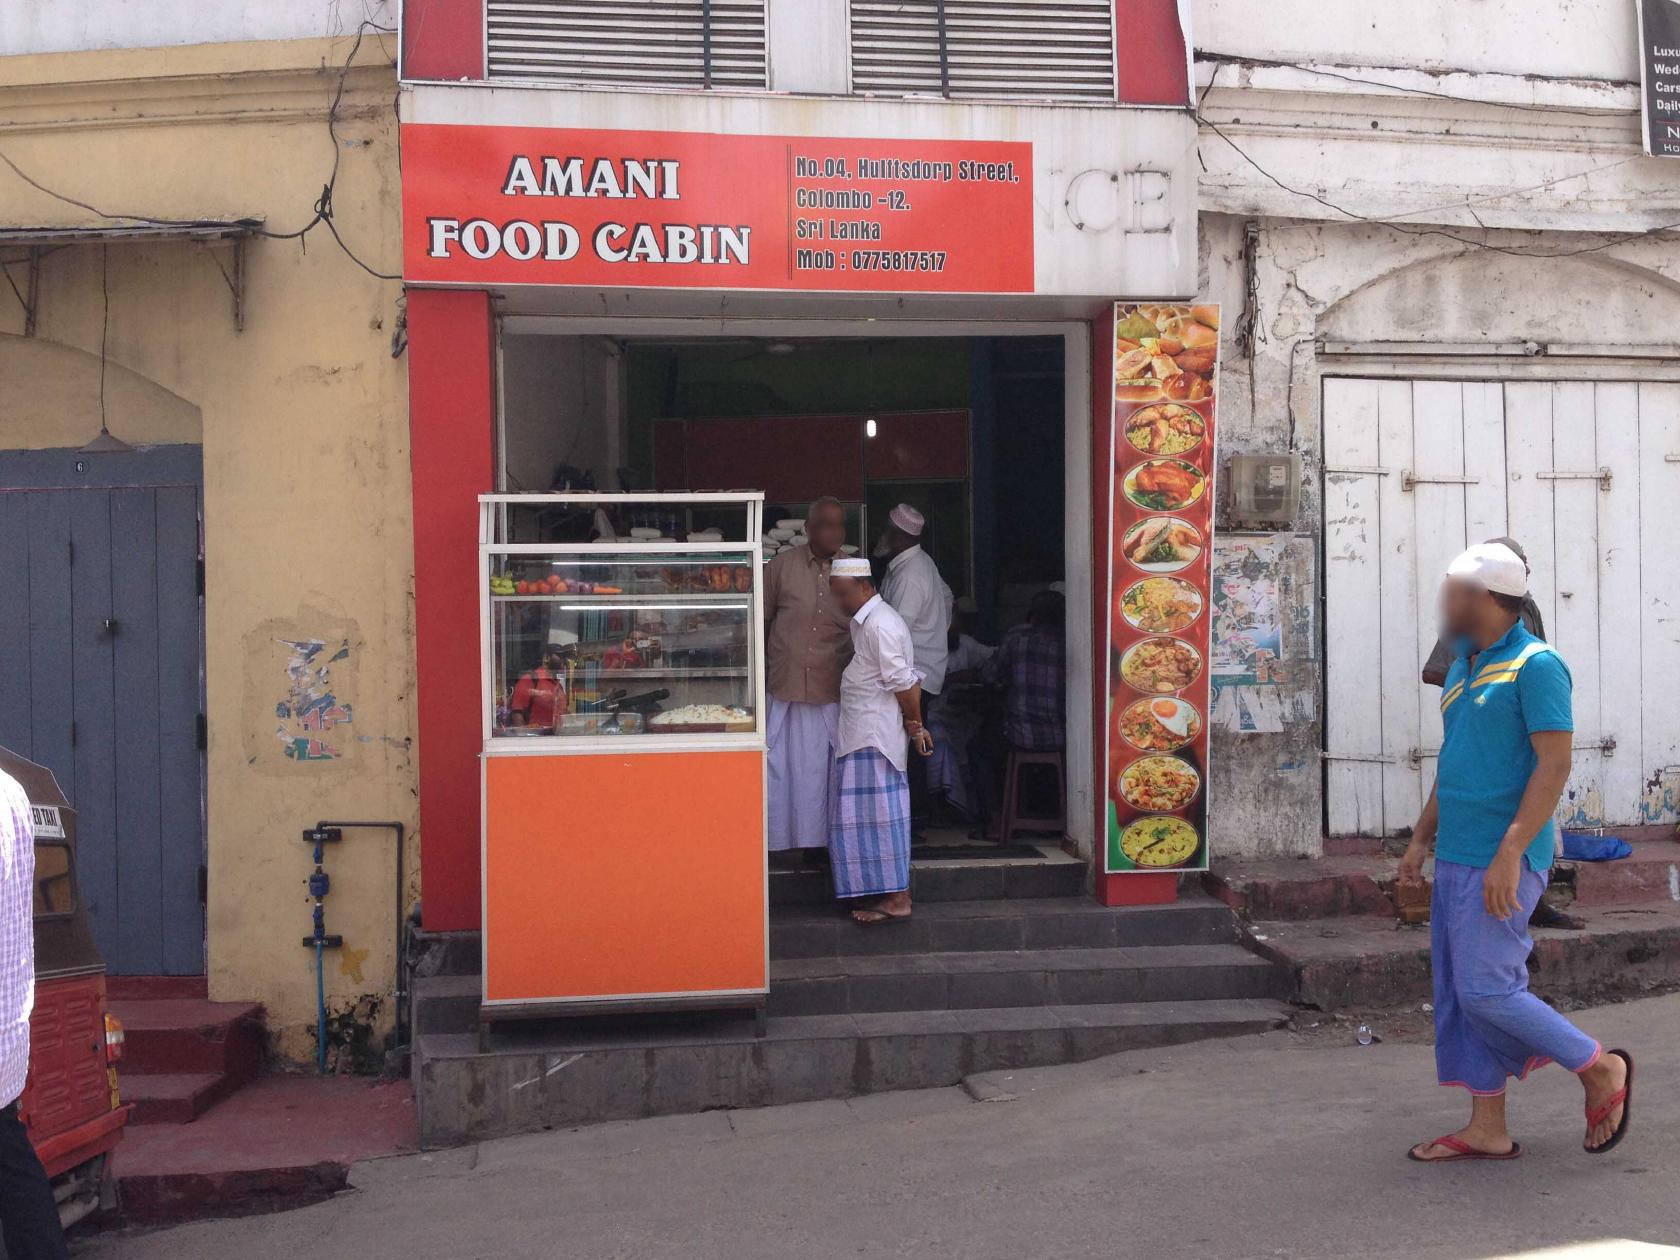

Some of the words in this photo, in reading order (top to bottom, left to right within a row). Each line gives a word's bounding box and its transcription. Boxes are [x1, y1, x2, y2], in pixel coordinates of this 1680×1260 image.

[1654, 63, 1680, 75] Wed
[502, 154, 681, 200] AMANI
[796, 156, 852, 181] No.04,
[858, 157, 953, 182] Hulftsdorp
[959, 159, 1020, 184] Street,
[796, 187, 872, 210] Colombo
[427, 216, 581, 261] FOOD
[592, 223, 752, 265] CABIN
[796, 218, 824, 240] Sri
[829, 219, 882, 241] Lanka
[797, 248, 835, 270] Mob
[852, 250, 947, 272] 0775817517
